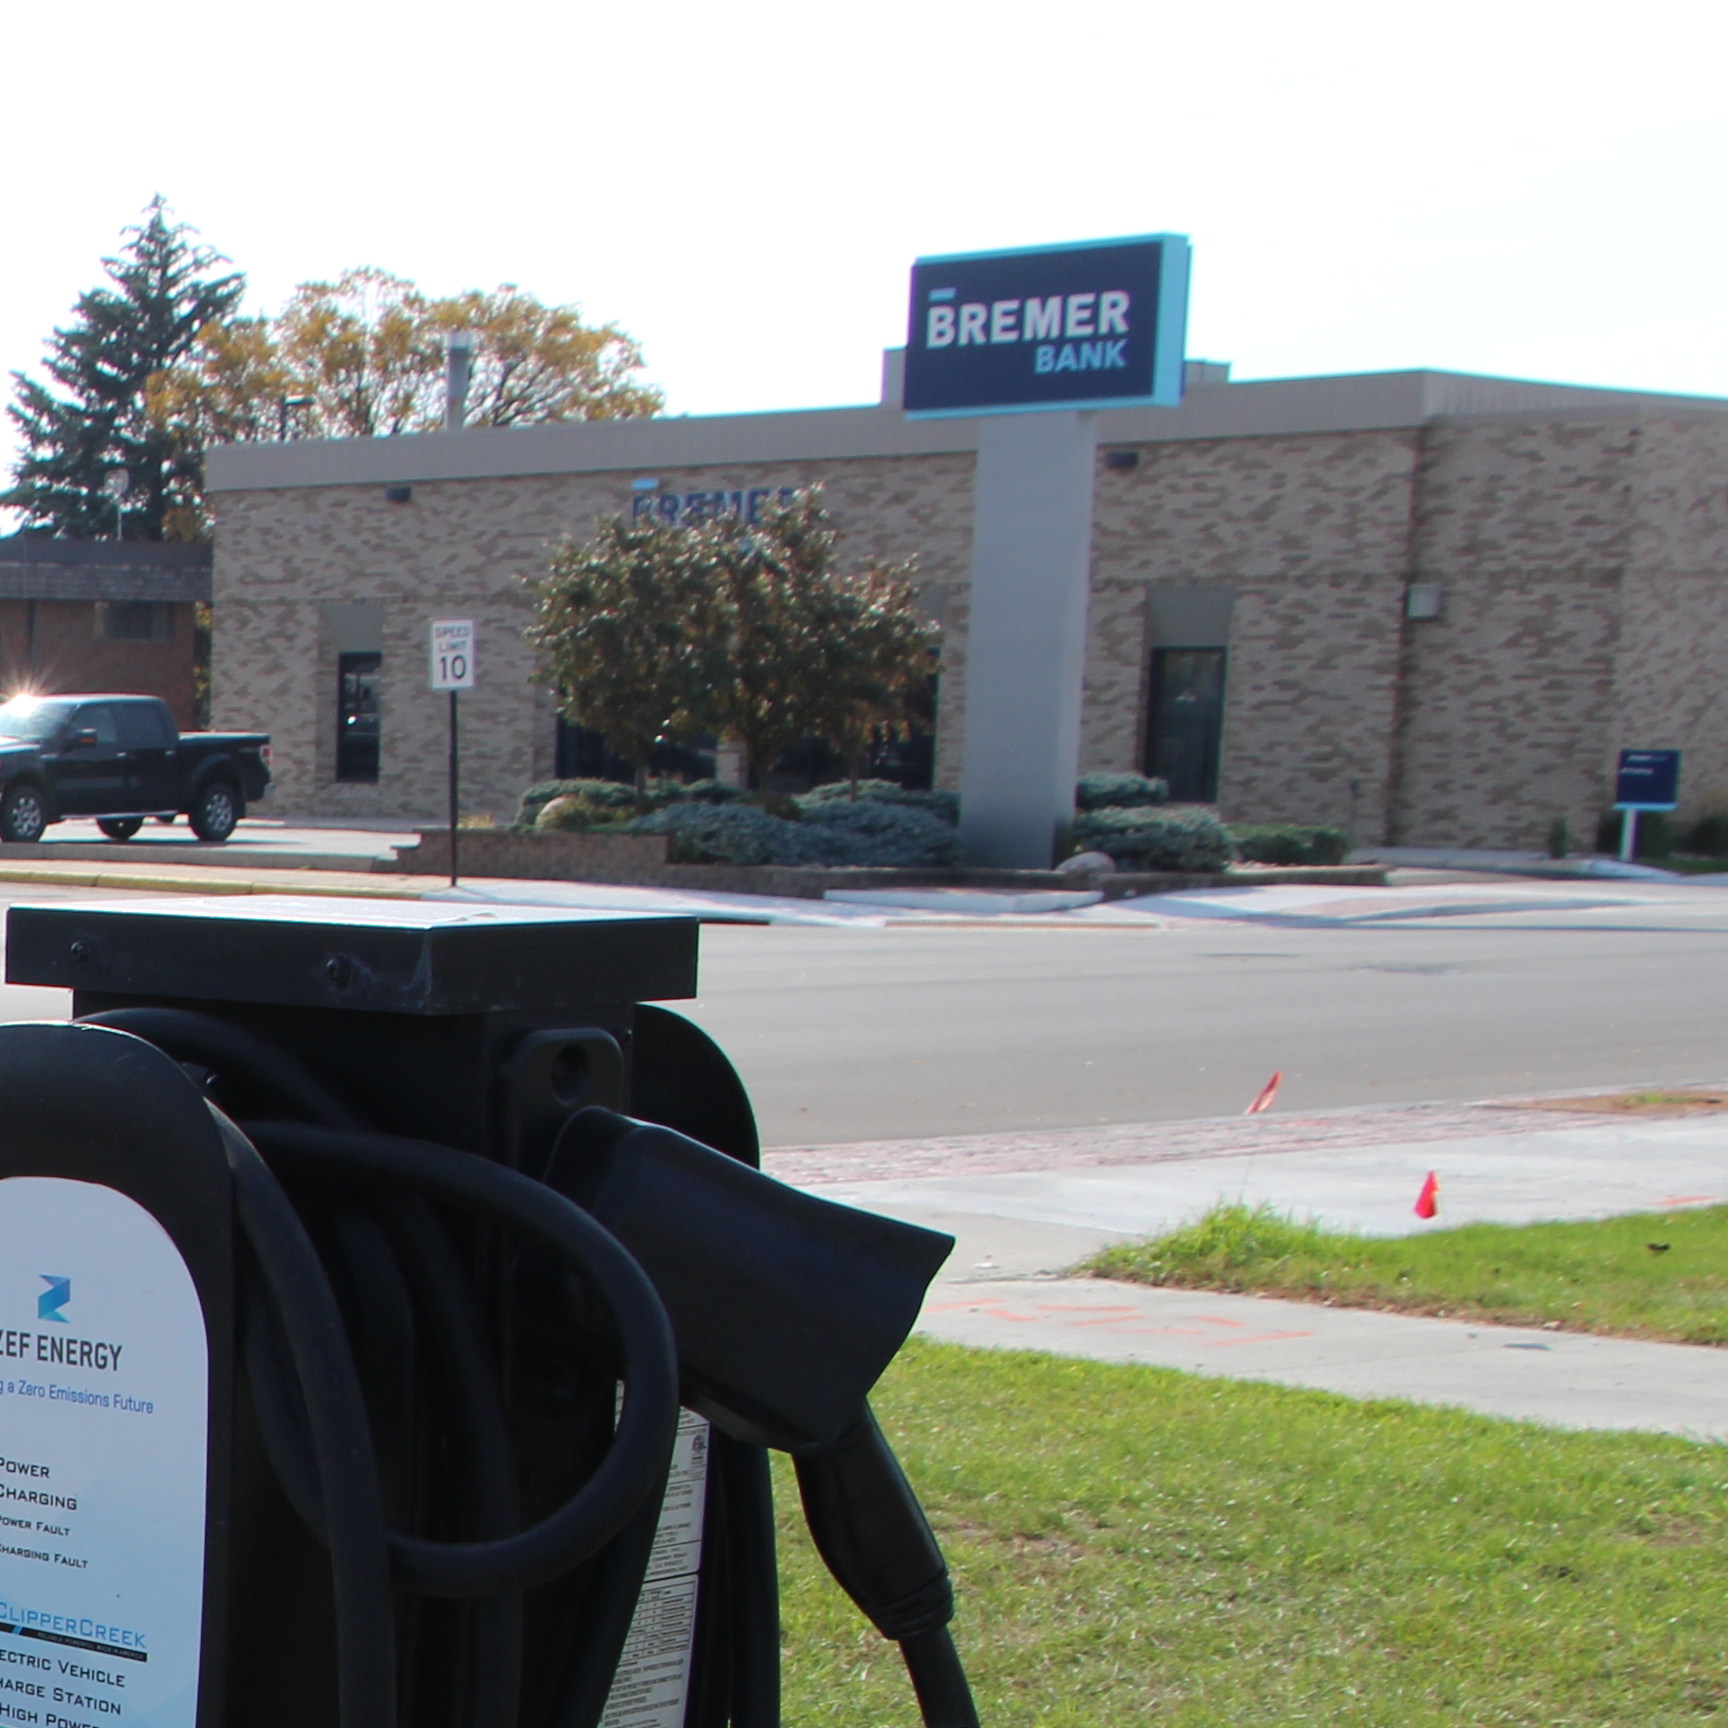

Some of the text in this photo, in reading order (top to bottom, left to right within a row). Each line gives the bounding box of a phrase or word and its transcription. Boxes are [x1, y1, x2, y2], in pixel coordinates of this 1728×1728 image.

[926, 290, 1131, 349] BREMER
[1034, 338, 1127, 375] BANK
[440, 655, 466, 680] 10
[37, 1334, 123, 1371] ENERGY
[7, 1381, 15, 1393] a
[18, 1379, 44, 1398] Zero
[49, 1384, 110, 1407] Emissions
[113, 1393, 154, 1414] Future
[36, 1521, 70, 1537] FAULT
[54, 1553, 88, 1569] FAULT
[58, 1659, 126, 1688] VEHICLE
[53, 1687, 121, 1715] STATION
